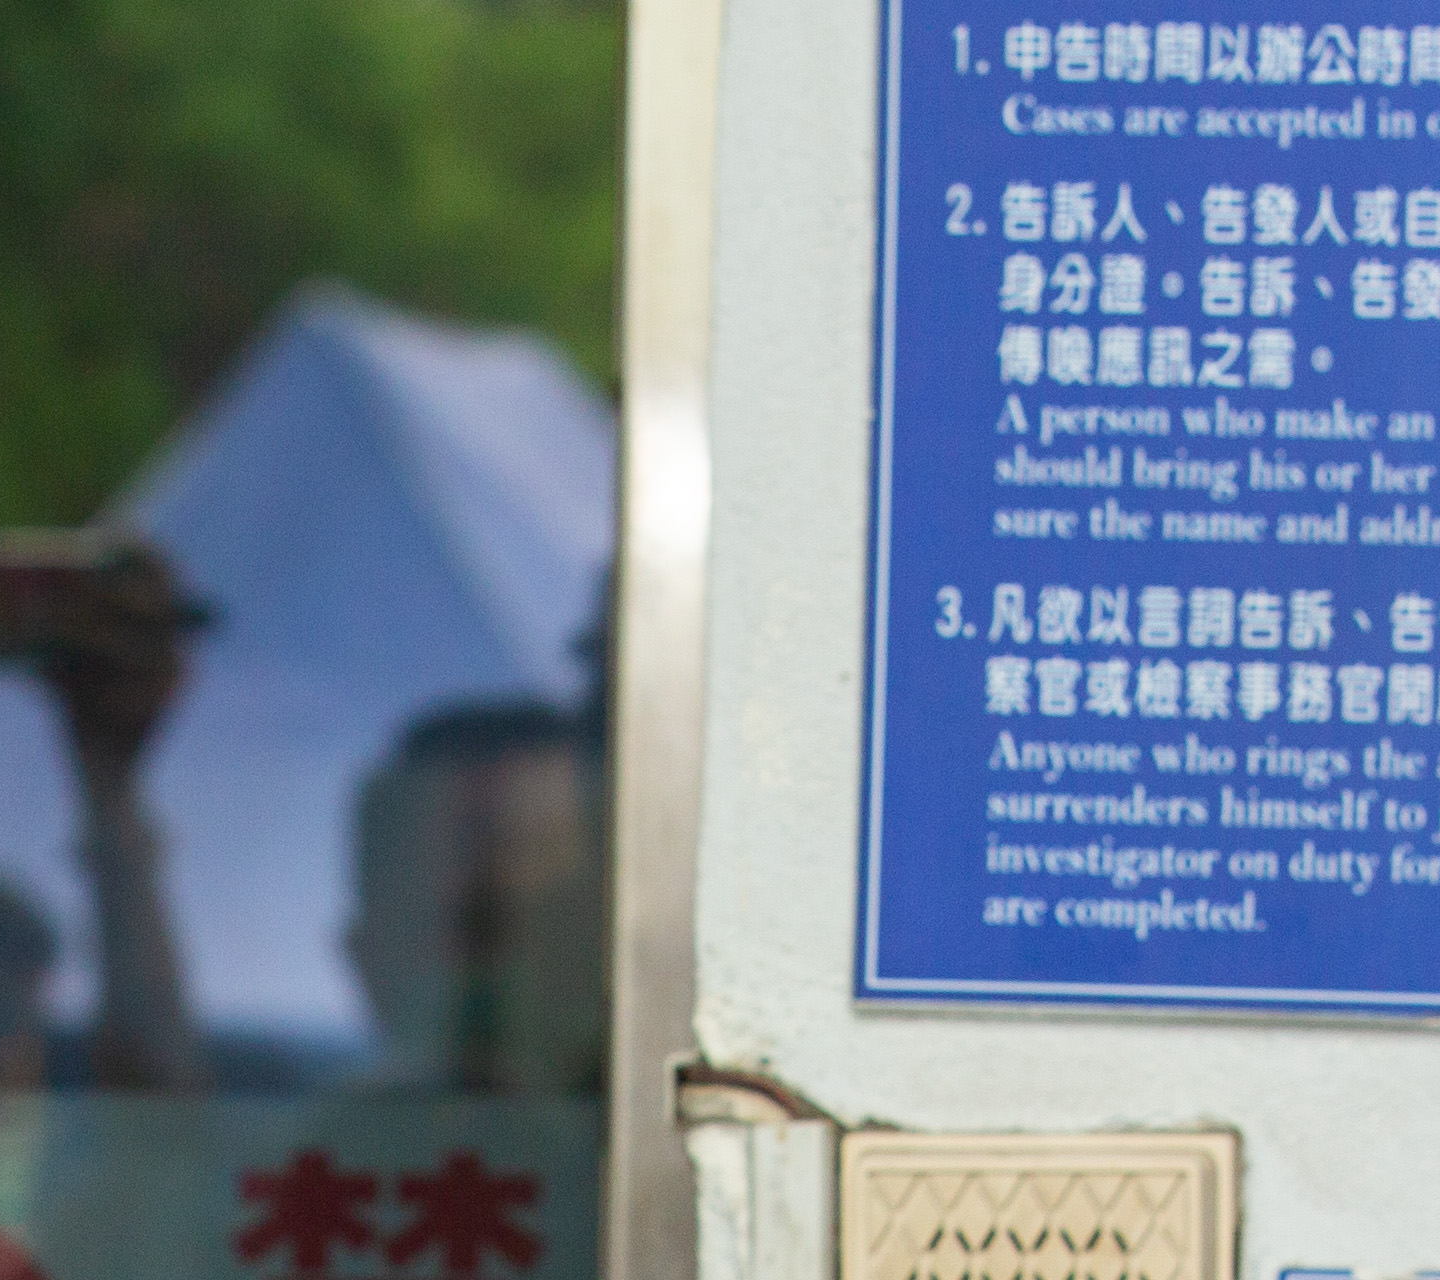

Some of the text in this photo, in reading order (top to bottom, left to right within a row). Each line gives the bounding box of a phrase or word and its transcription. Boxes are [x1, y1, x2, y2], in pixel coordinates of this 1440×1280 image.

[953, 23, 990, 75] 1.
[1002, 94, 1115, 138] Cases
[1124, 105, 1189, 138] are
[1197, 96, 1366, 151] accepted
[1377, 98, 1418, 140] in
[945, 183, 987, 237] 2.
[994, 394, 1028, 434] A
[1038, 405, 1171, 446] person
[1181, 395, 1266, 439] who
[1274, 398, 1378, 439] make
[1387, 411, 1435, 442] an
[994, 443, 1122, 487] should
[1132, 446, 1239, 502] bring
[1248, 446, 1307, 491] his
[1315, 459, 1361, 492] or
[1370, 450, 1436, 494] her
[993, 508, 1078, 539] sure
[1088, 496, 1152, 541] the
[1161, 511, 1267, 543] name
[1276, 502, 1350, 544] and
[934, 584, 978, 639] 3.
[988, 729, 1142, 785] Anyone
[1150, 731, 1237, 776] who
[1245, 734, 1351, 791] rings
[1362, 737, 1427, 781] the
[986, 782, 1209, 827] surrenders
[1219, 784, 1378, 832] himself
[1383, 799, 1428, 833] to
[985, 831, 1221, 891] investigator
[1227, 848, 1280, 881] on
[1288, 840, 1379, 896] duty
[982, 895, 1048, 927] are
